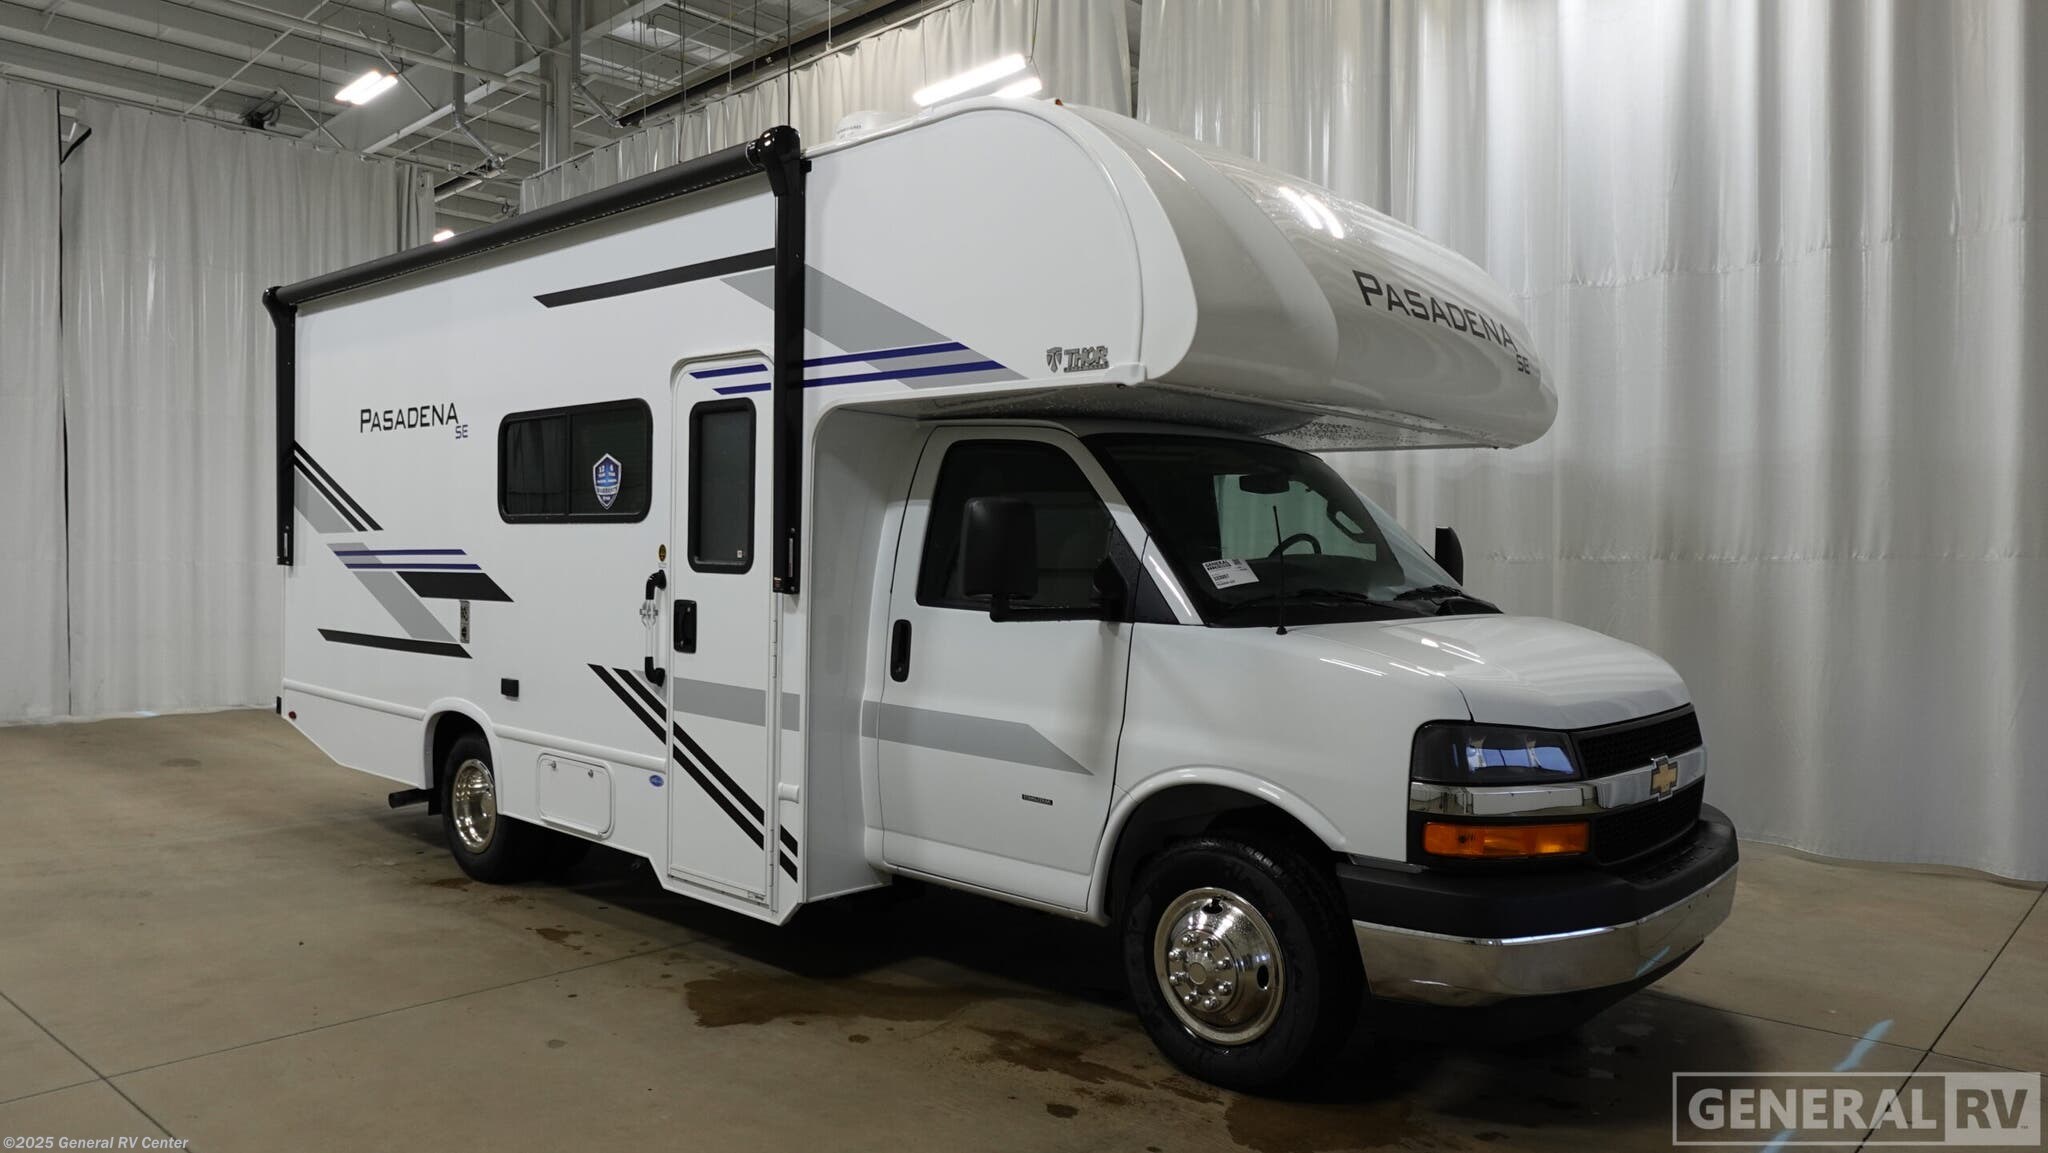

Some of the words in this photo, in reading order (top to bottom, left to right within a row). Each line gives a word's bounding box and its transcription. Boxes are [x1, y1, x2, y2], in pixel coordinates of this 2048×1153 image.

[1352, 269, 1518, 352] PASADENA
[1516, 354, 1531, 375] SE
[1063, 345, 1108, 369] THOR
[360, 402, 459, 433] PASADENA
[455, 424, 468, 439] SE
